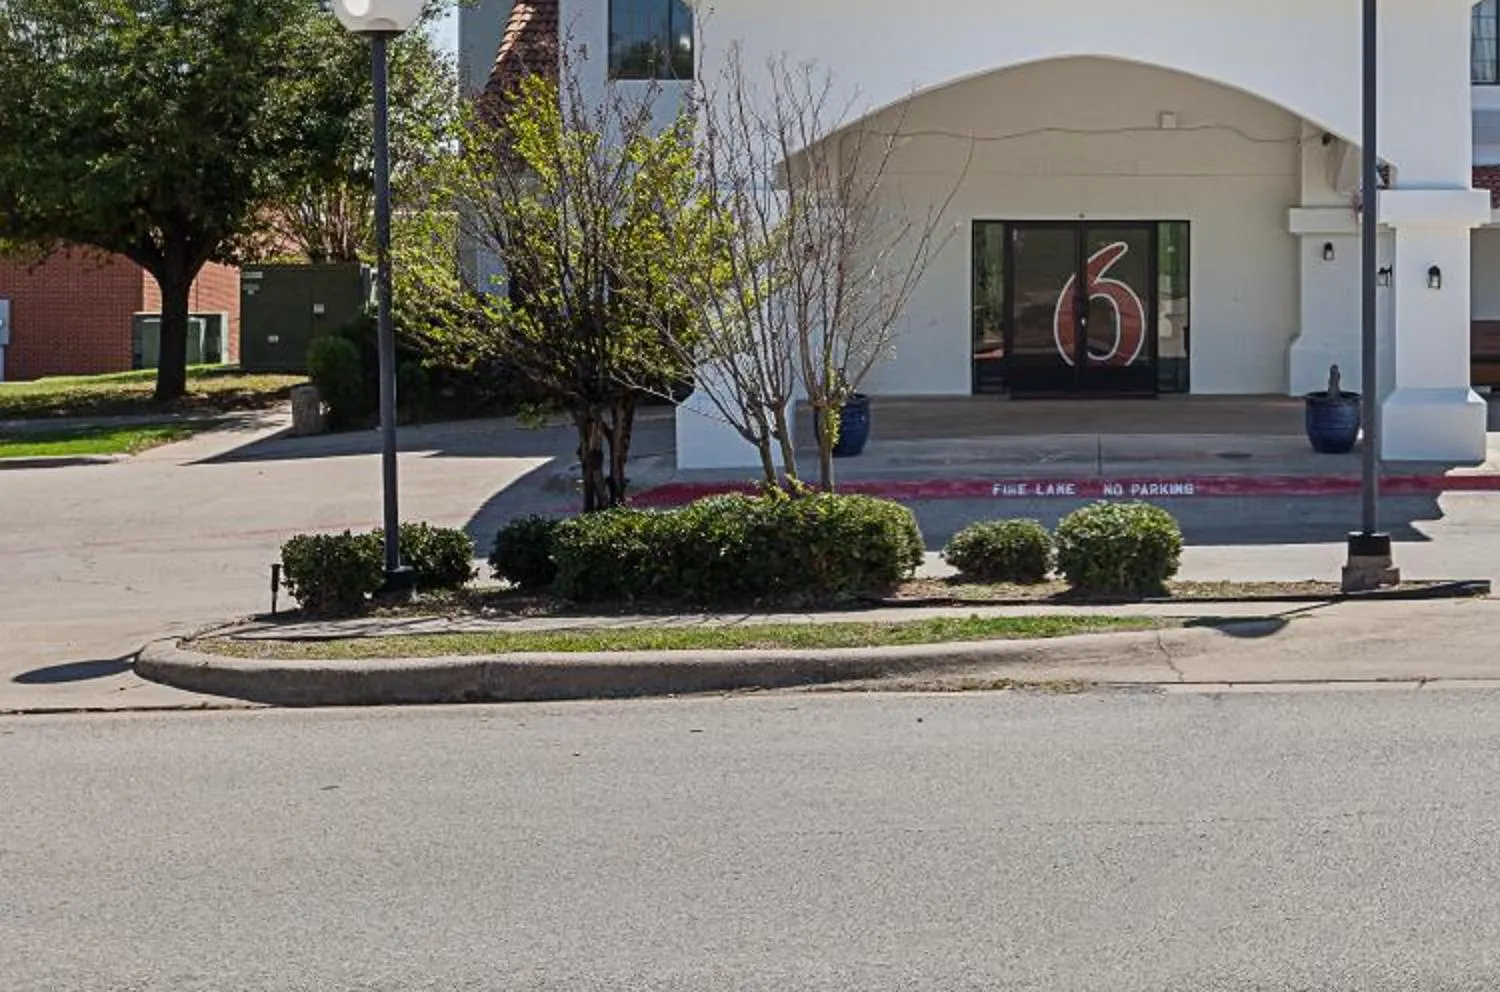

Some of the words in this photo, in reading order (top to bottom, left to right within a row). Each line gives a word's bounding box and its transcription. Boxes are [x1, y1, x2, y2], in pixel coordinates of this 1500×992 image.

[1053, 241, 1145, 366] 6
[1035, 483, 1076, 496] LANE
[1103, 482, 1123, 496] NO
[1131, 483, 1194, 496] PARKING
